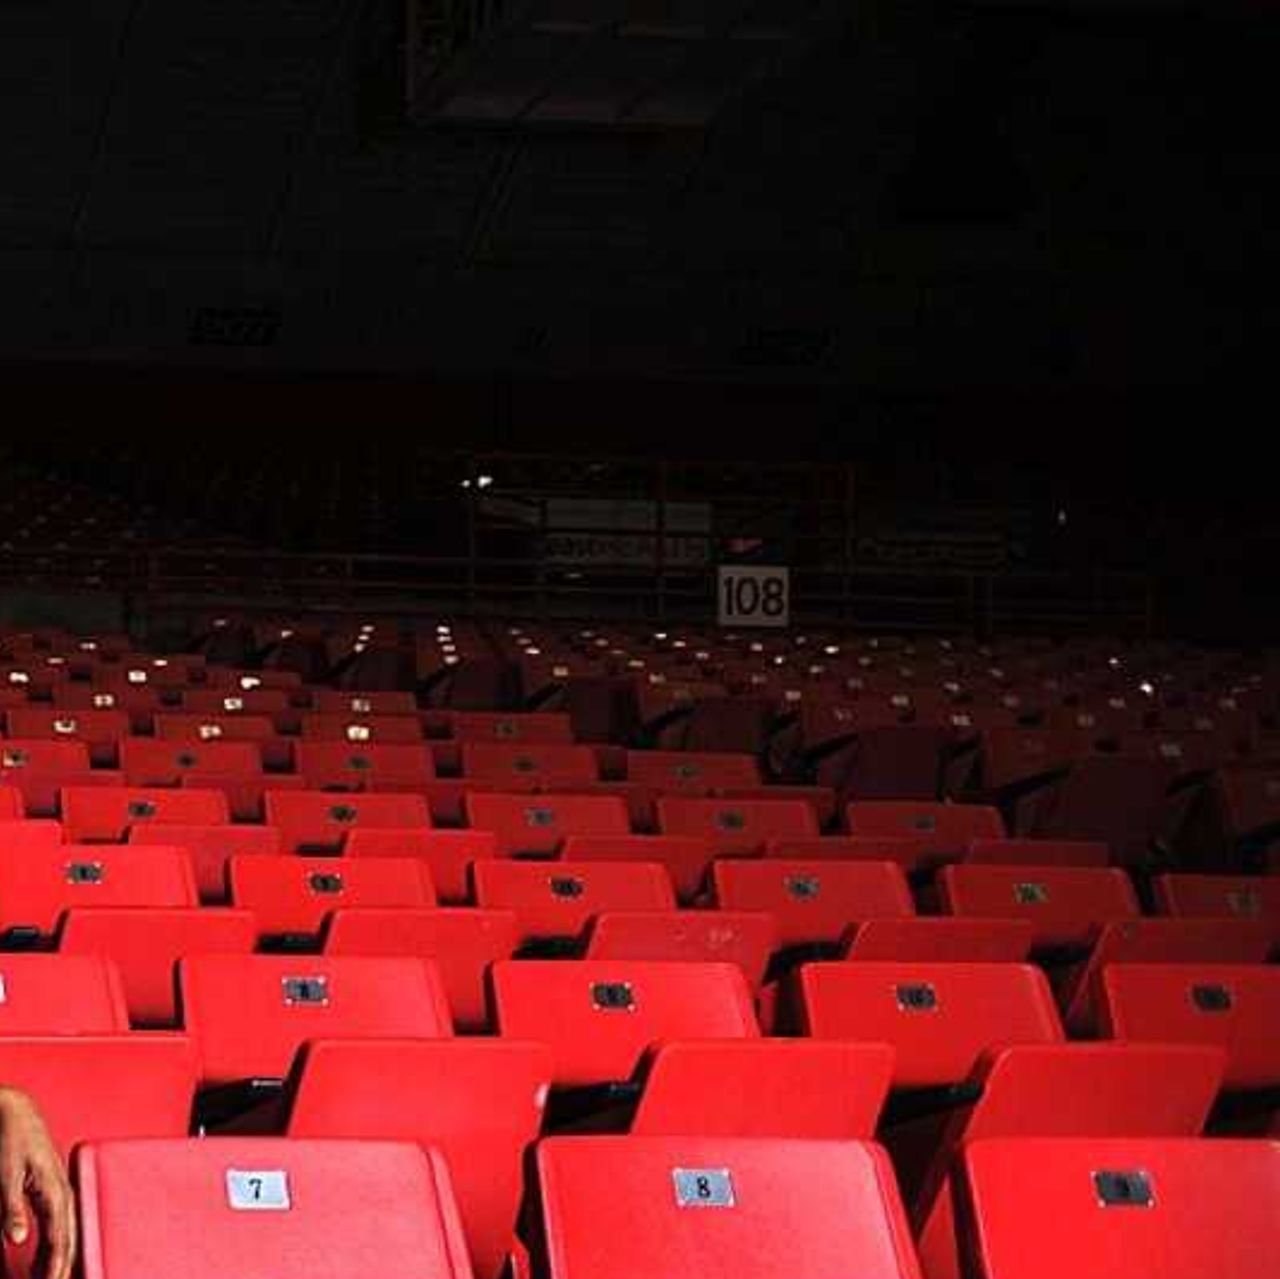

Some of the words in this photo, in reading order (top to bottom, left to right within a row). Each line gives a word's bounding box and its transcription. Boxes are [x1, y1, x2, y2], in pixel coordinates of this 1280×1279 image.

[724, 576, 784, 616] 108
[247, 1178, 264, 1201] 7
[695, 1177, 712, 1200] 8
